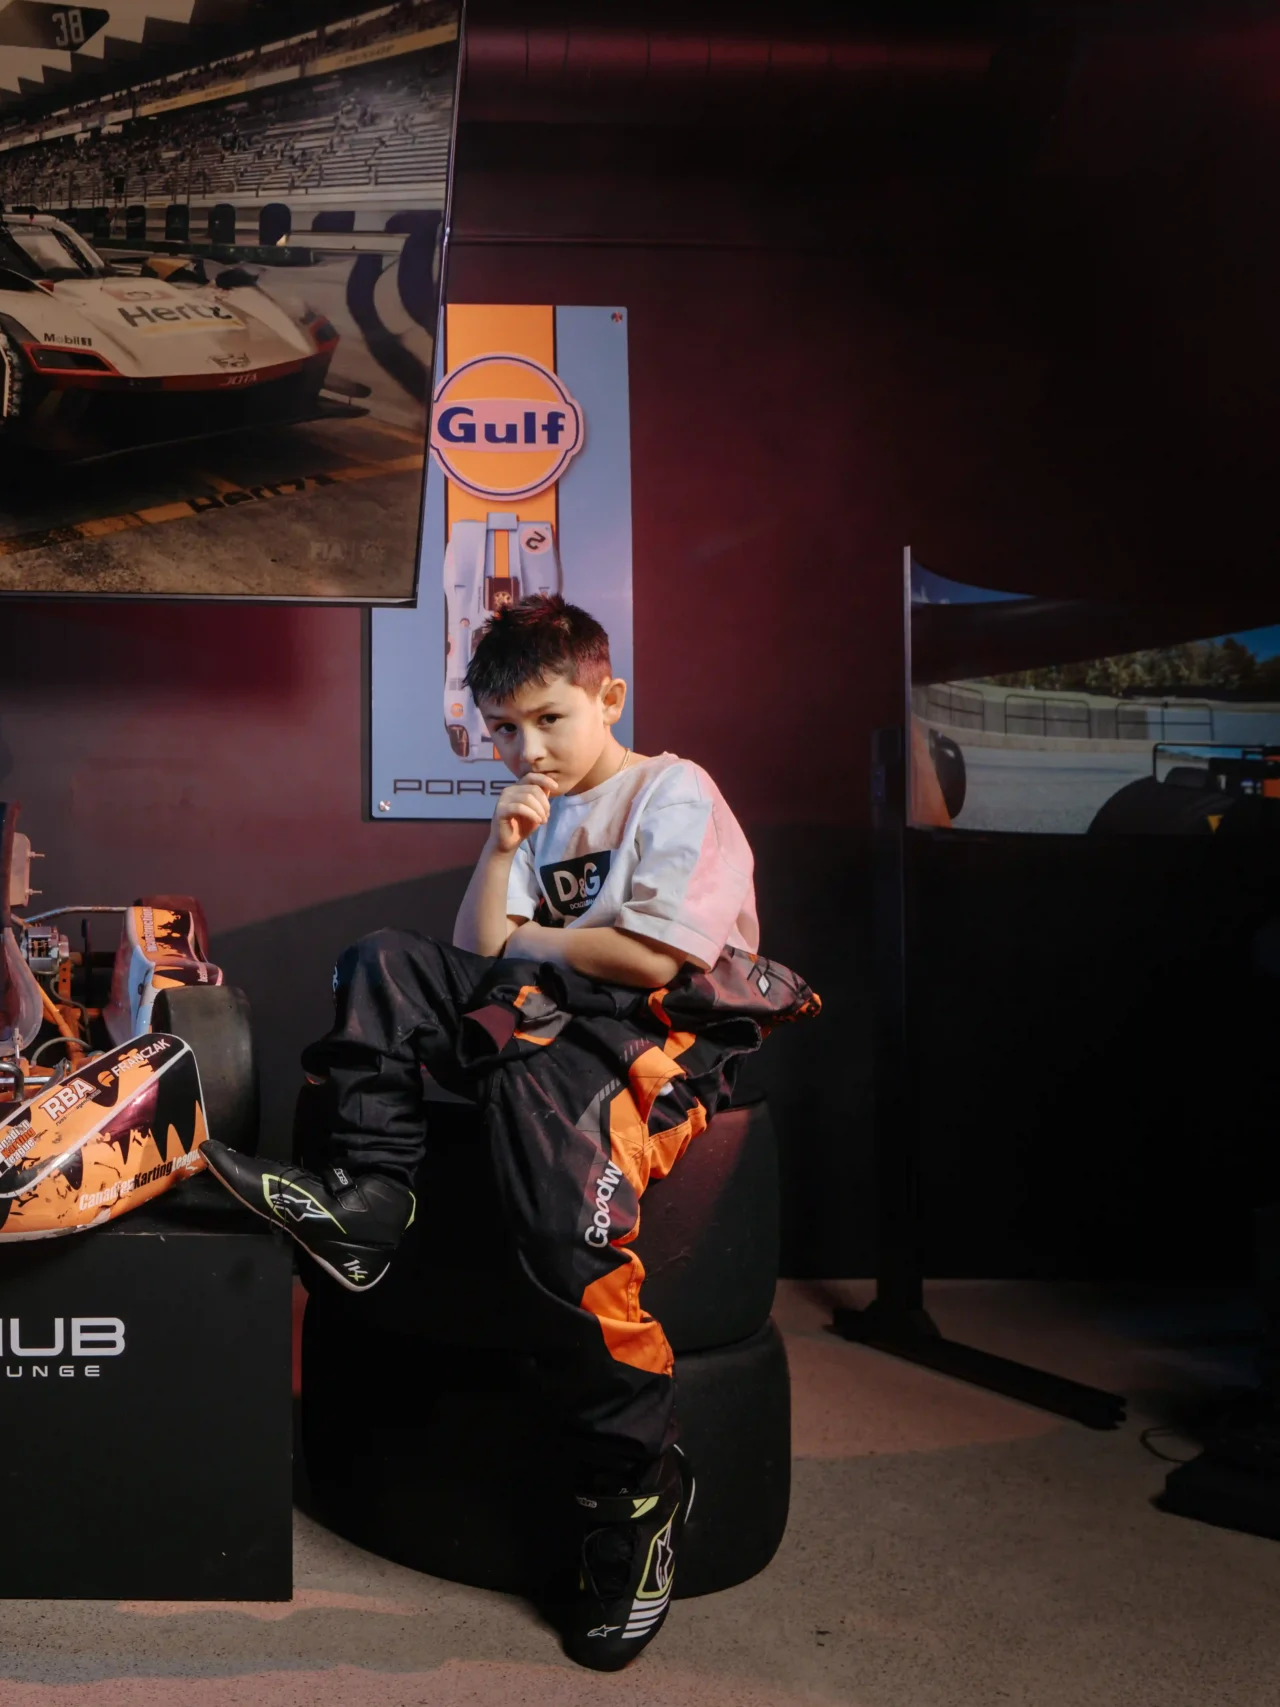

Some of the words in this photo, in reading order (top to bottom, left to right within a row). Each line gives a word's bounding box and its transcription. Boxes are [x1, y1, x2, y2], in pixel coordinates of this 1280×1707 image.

[51, 8, 85, 47] 38
[117, 302, 233, 327] Hertz
[437, 406, 566, 444] Gulf
[552, 862, 600, 903] D&G
[112, 1038, 171, 1077] FRANCZAK
[38, 1077, 98, 1121] RBA
[1, 1126, 37, 1158] Karting
[4, 1139, 37, 1168] League
